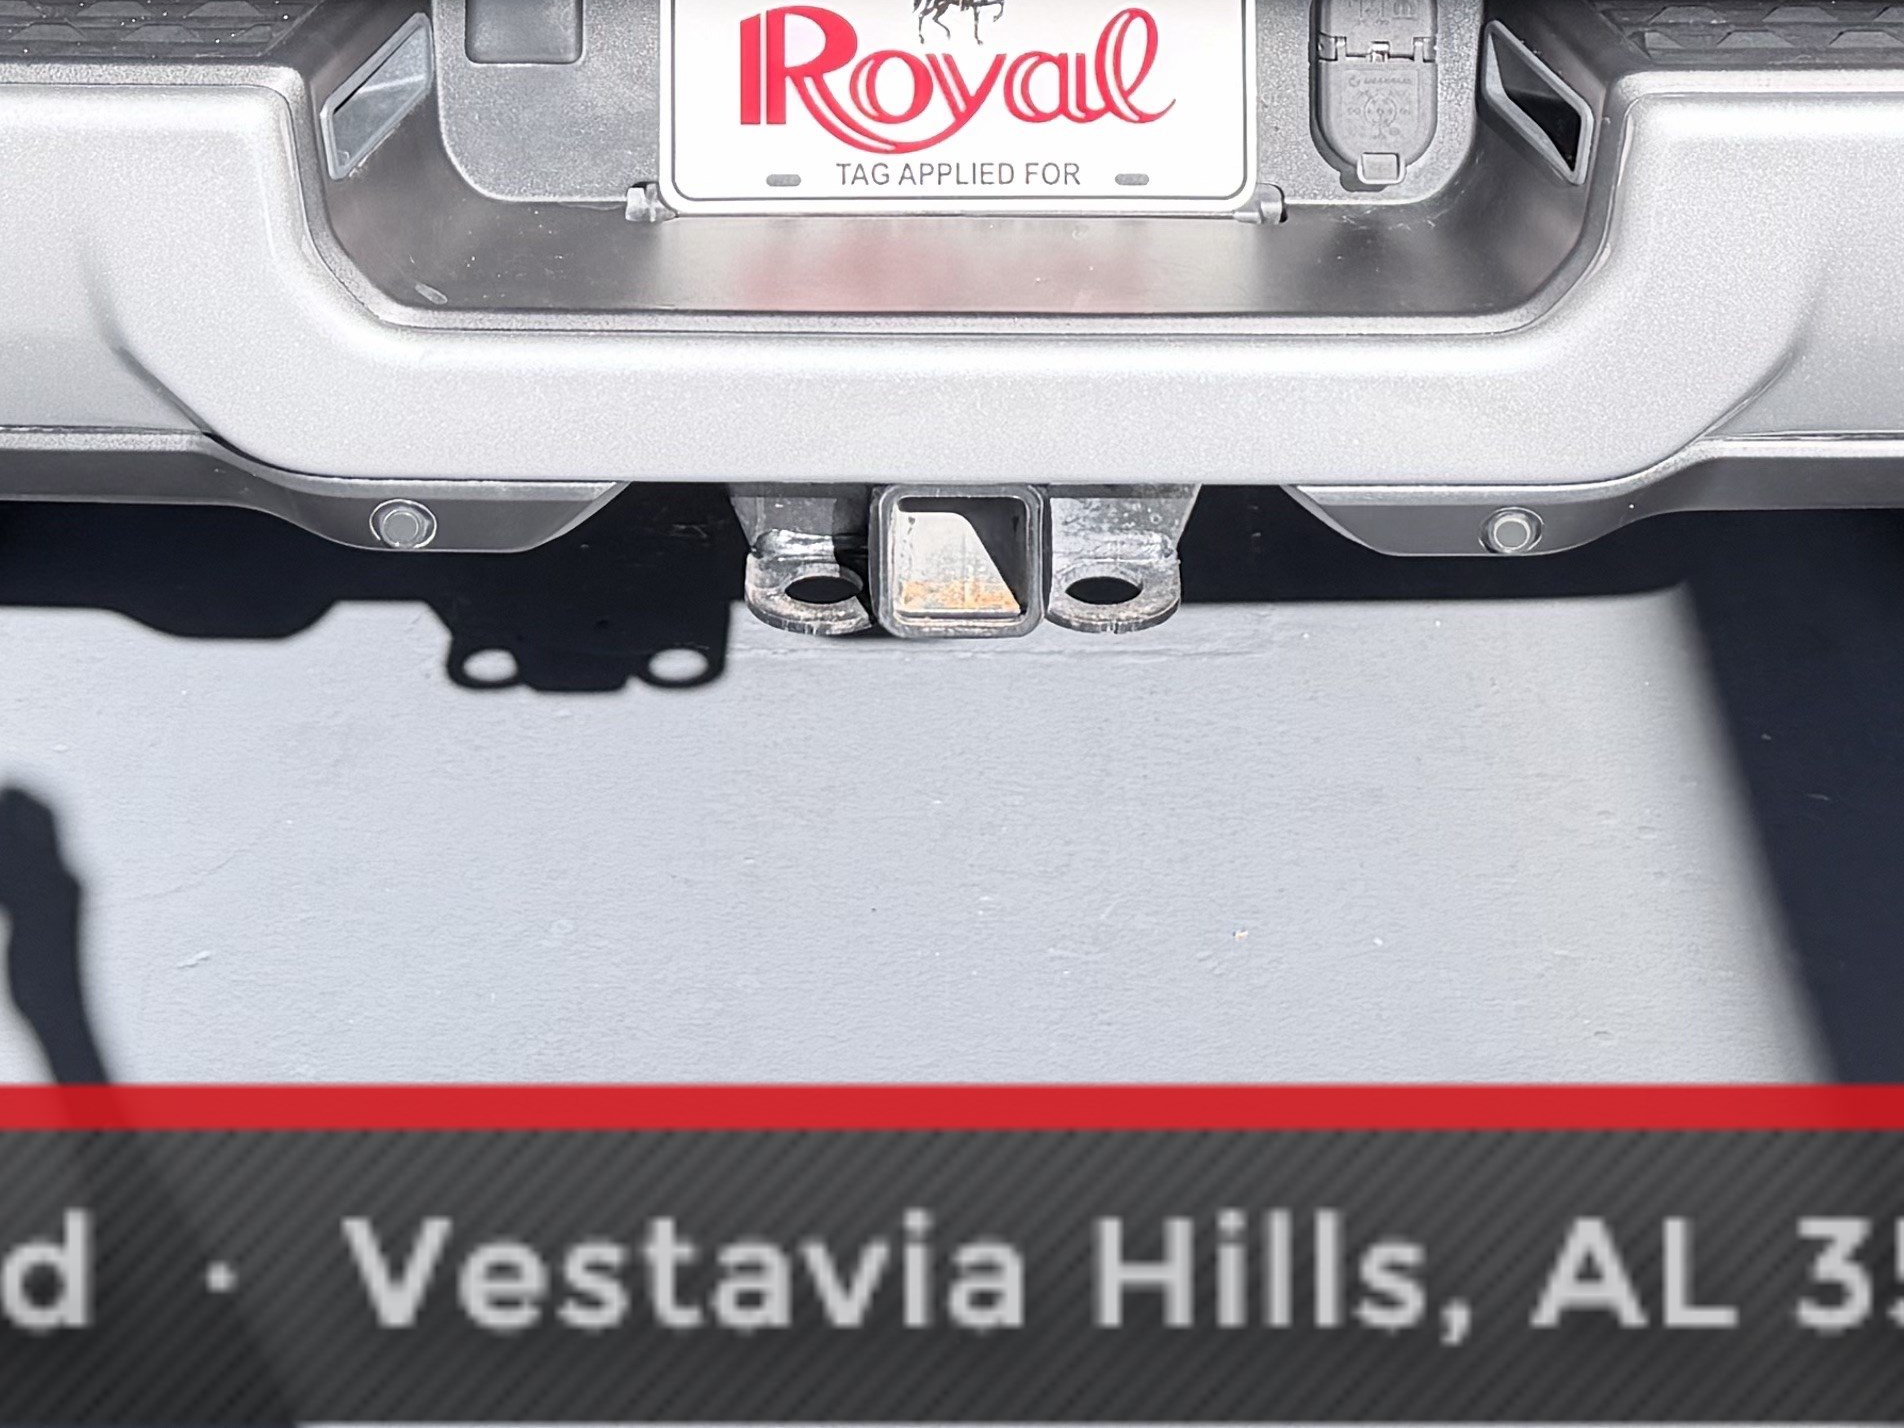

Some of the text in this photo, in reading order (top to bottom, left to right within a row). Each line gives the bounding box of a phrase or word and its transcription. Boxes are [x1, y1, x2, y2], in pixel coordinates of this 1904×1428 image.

[739, 5, 1177, 155] Royal
[836, 162, 1081, 186] TAG APPLIED FOR
